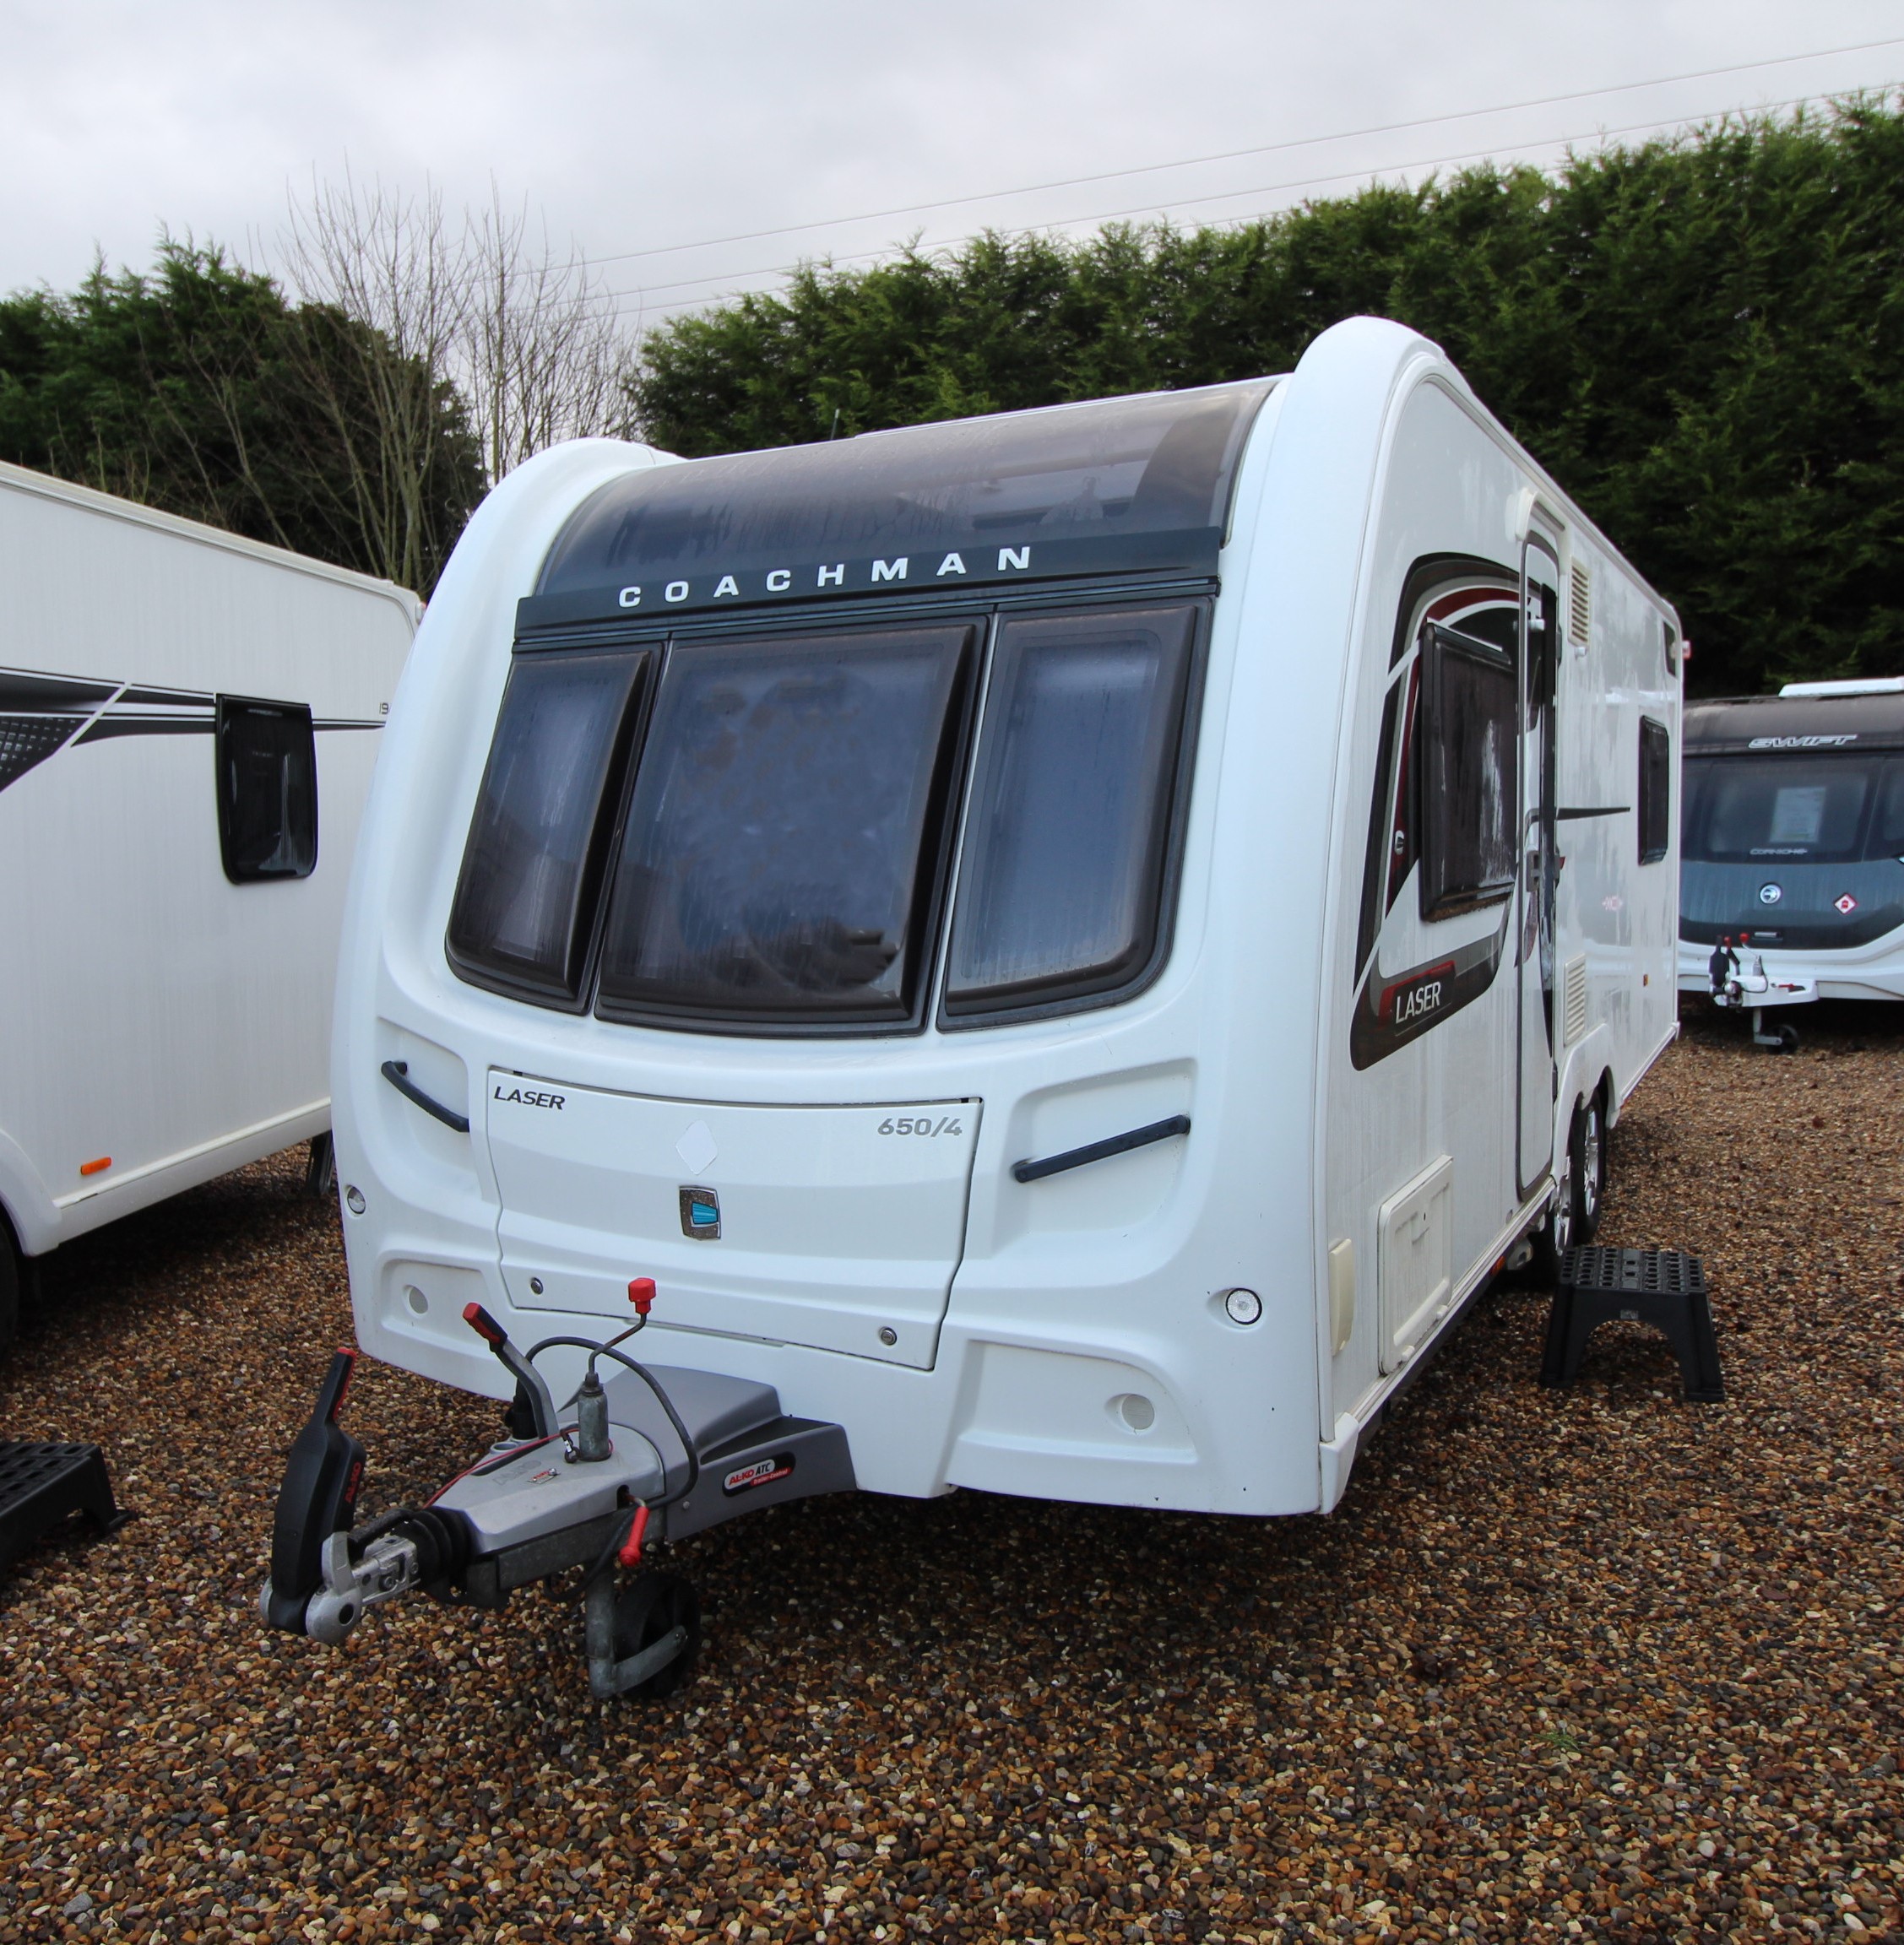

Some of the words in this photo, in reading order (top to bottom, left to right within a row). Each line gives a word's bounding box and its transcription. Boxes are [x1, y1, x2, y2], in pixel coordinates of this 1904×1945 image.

[619, 546, 1030, 608] COACHMAN
[1749, 734, 1858, 748] SWIFT
[1396, 981, 1441, 1024] LASER
[494, 1086, 566, 1110] LASER
[877, 1117, 963, 1137] 650/4
[756, 1462, 771, 1476] ATC
